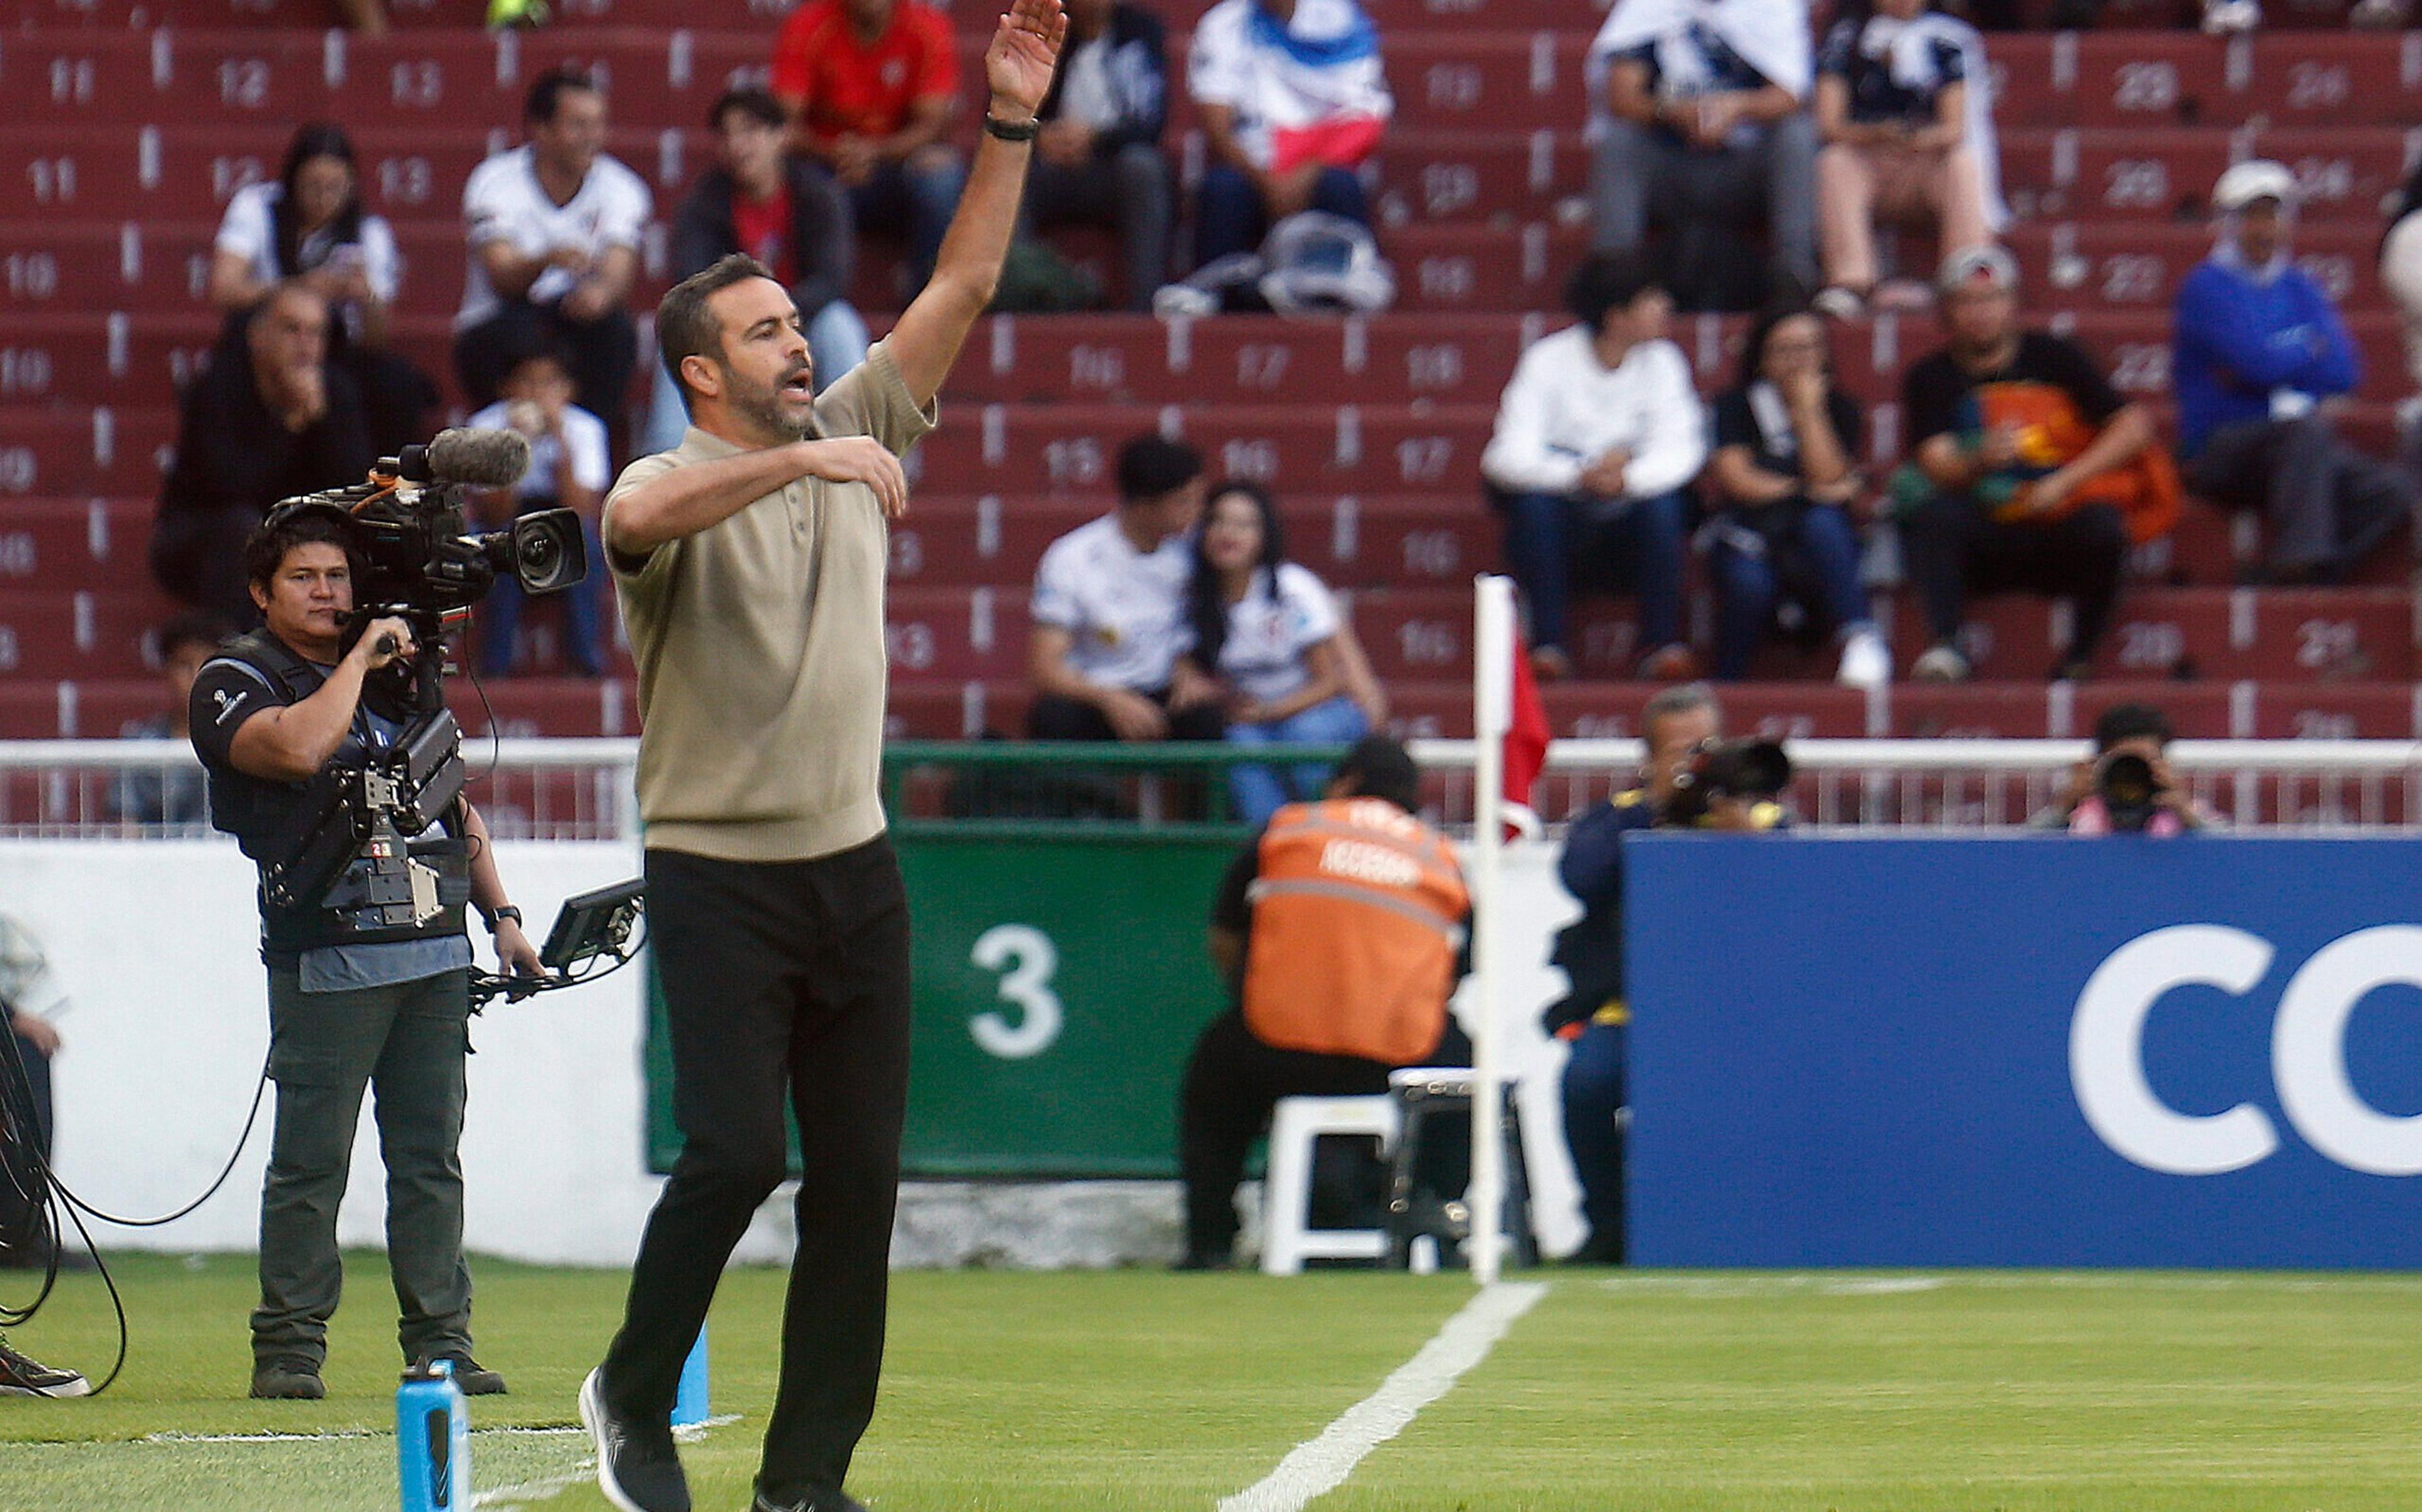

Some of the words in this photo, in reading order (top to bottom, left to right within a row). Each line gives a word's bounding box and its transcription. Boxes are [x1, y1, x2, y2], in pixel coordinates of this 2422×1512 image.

[50, 58, 93, 102] 11
[219, 60, 269, 107] 12
[391, 61, 442, 106] 13
[28, 158, 76, 201] 11
[377, 158, 431, 204] 13
[5, 253, 57, 297] 10
[1236, 344, 1291, 388] 17
[1396, 437, 1453, 480] 17
[969, 922, 1063, 1059] 3
[2068, 922, 2422, 1177] CO
